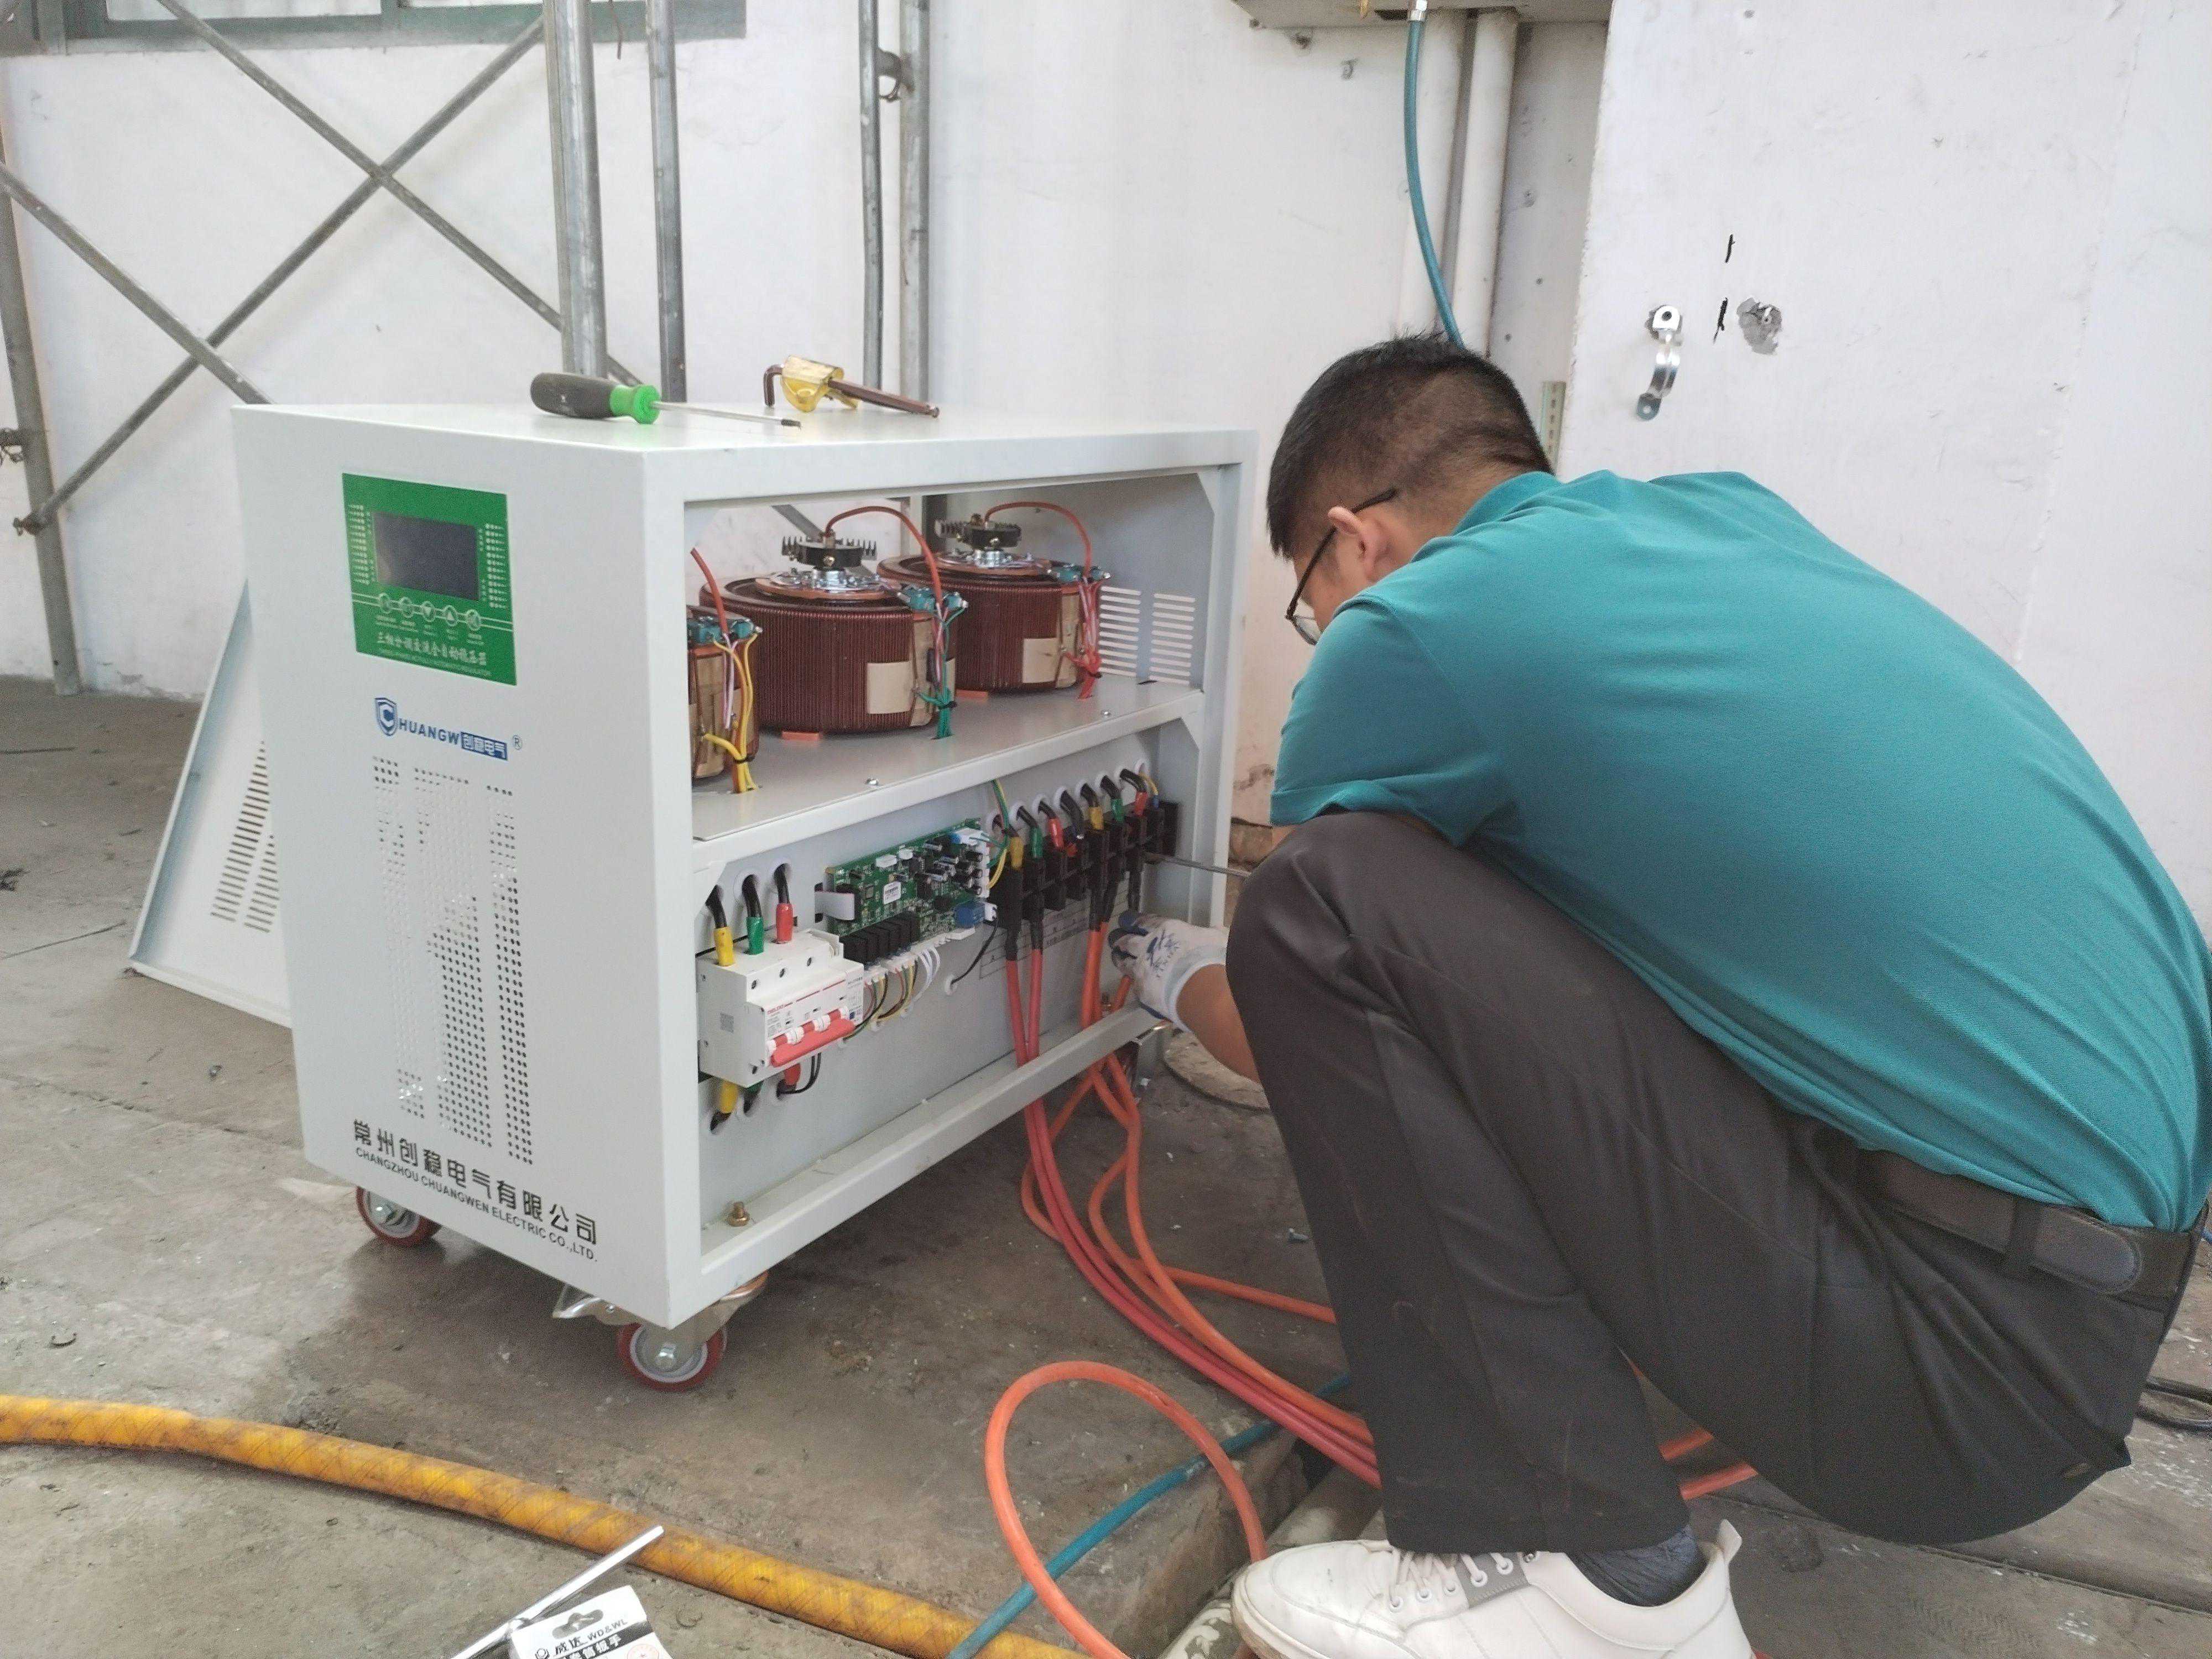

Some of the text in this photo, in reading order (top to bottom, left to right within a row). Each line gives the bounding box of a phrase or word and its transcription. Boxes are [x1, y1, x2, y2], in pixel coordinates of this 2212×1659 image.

[354, 1118, 597, 1245] 常州创稳电气有限公司
[356, 1146, 419, 1182] CHANGZHOU
[421, 1175, 489, 1214] CHUANGWEN
[492, 1204, 546, 1239] ELECTRIC
